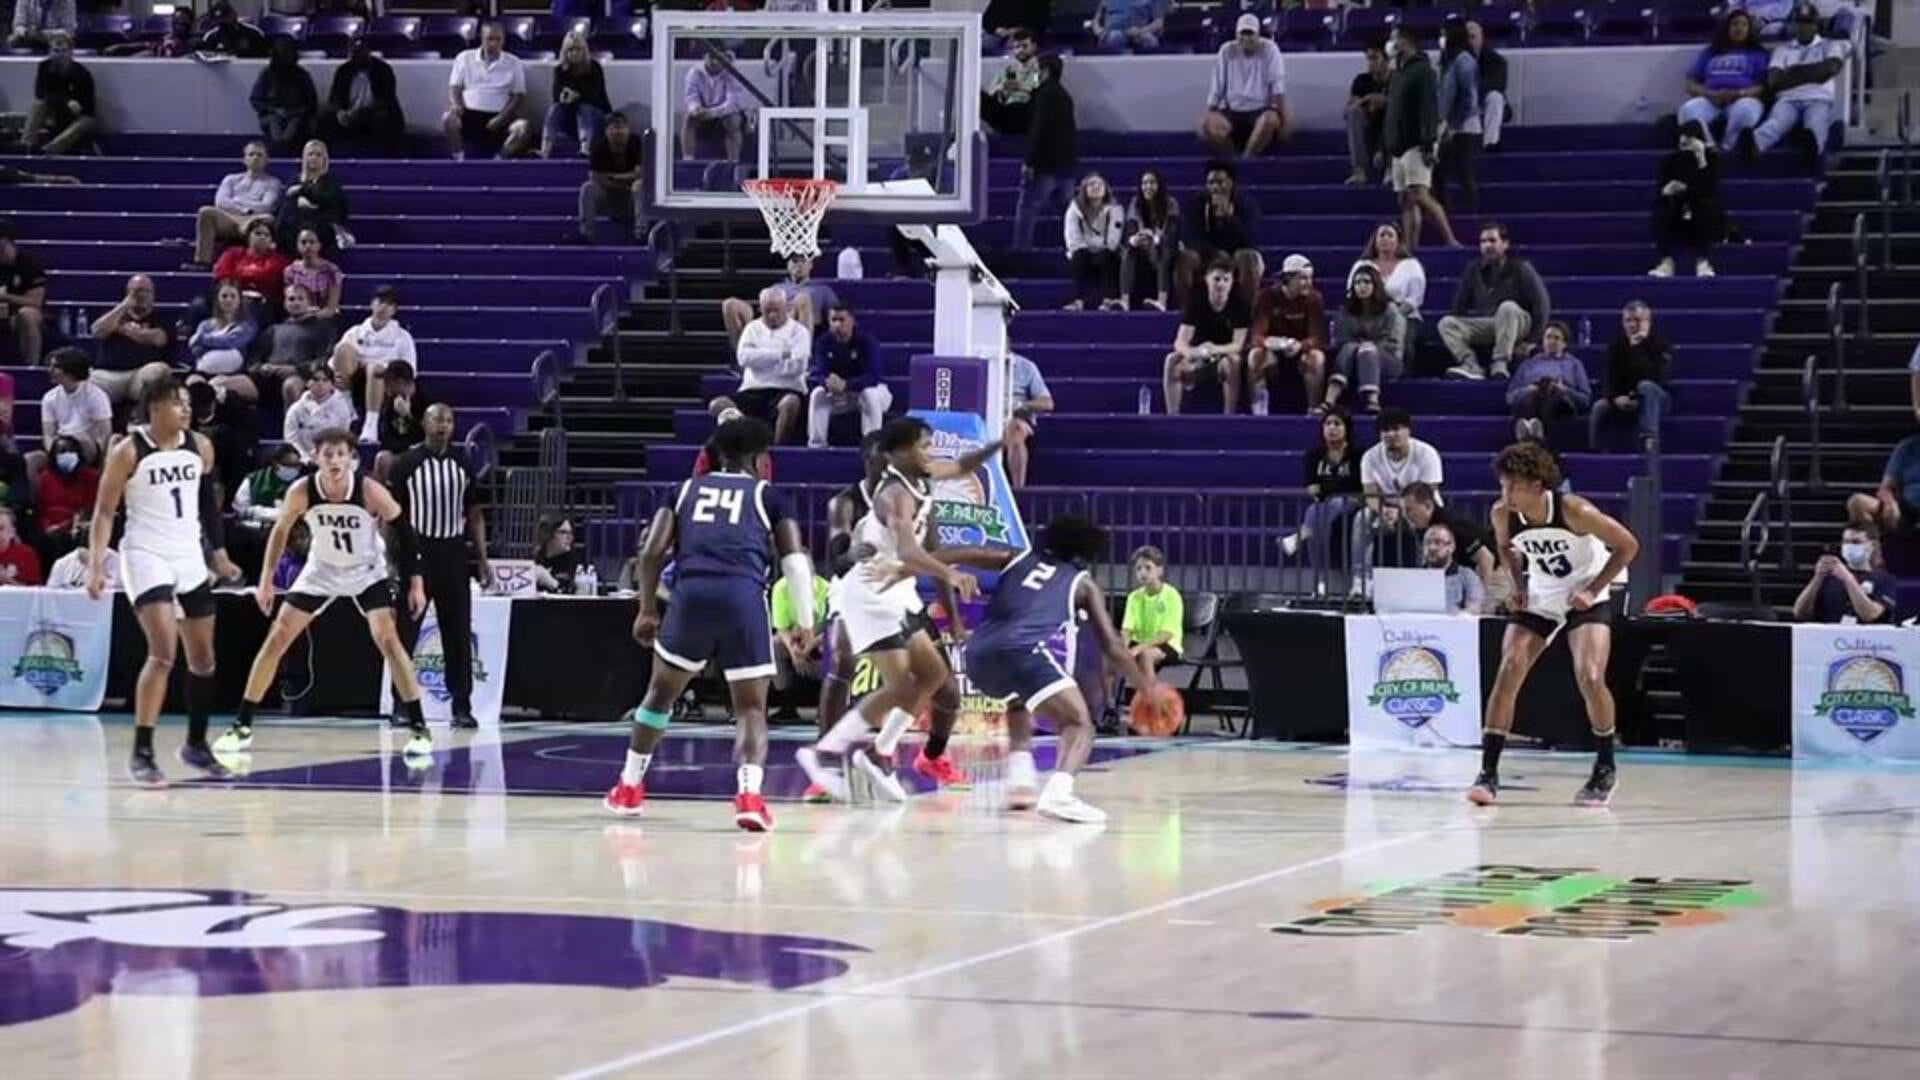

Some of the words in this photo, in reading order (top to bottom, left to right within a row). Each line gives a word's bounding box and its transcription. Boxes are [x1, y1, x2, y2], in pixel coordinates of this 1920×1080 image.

[149, 463, 196, 485] IMG
[170, 486, 183, 518] 1
[692, 485, 744, 525] 24
[317, 514, 361, 529] IMG
[953, 504, 993, 525] PALMS
[332, 530, 354, 554] 11
[937, 525, 972, 546] SSIC
[1523, 540, 1570, 555] IMG
[1021, 561, 1057, 591] 2
[1536, 553, 1573, 578] 13
[1375, 682, 1401, 697] CITY
[1403, 681, 1420, 694] OF
[1824, 693, 1849, 706] CITY
[1851, 691, 1871, 704] OF
[1388, 698, 1439, 712] CLASSIC
